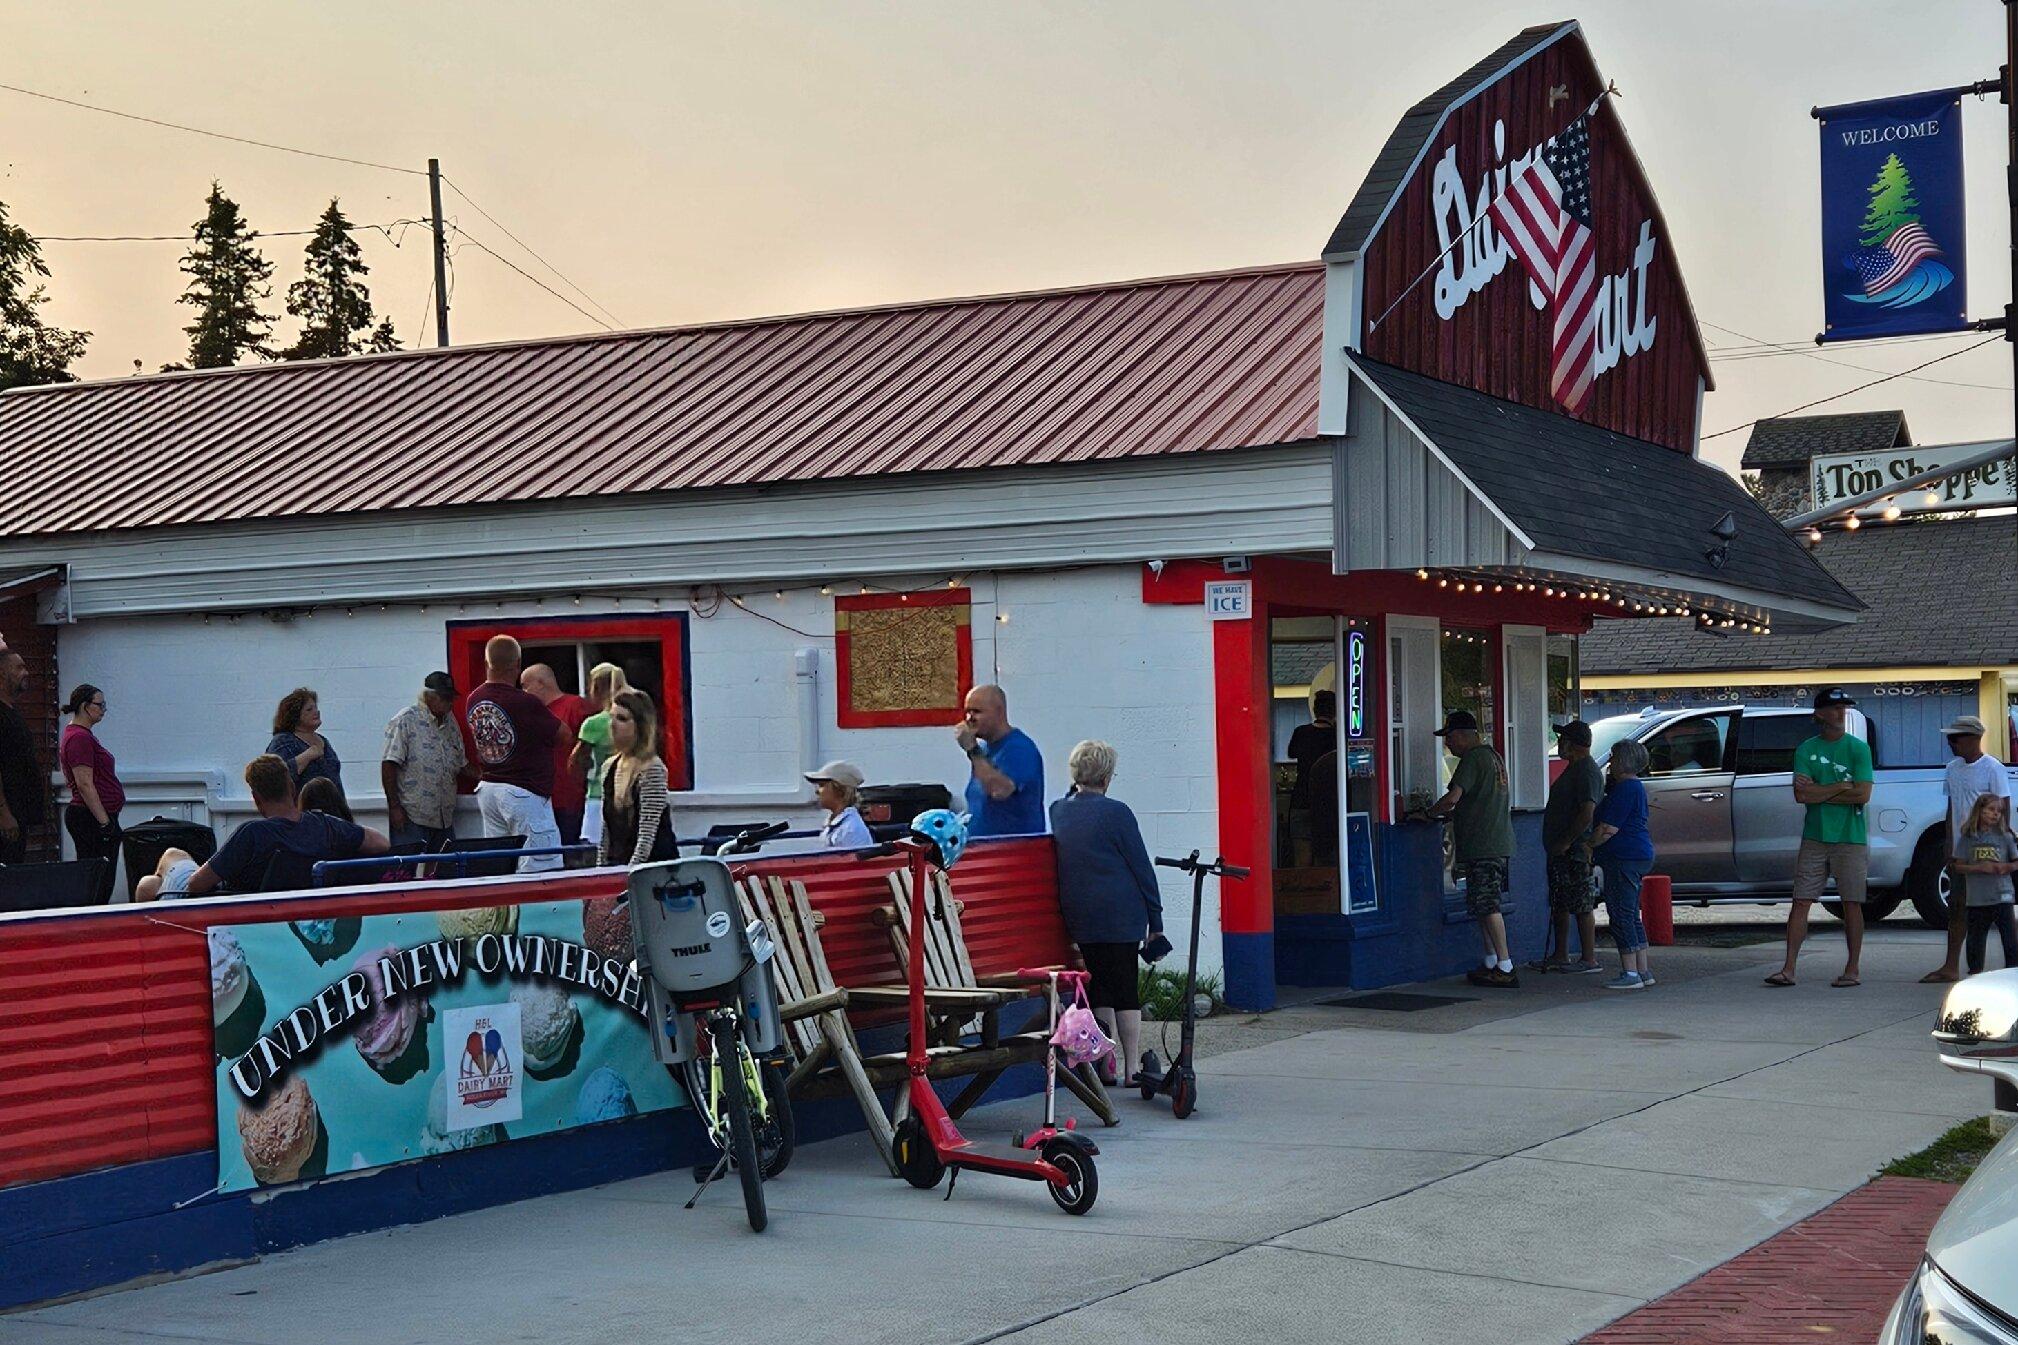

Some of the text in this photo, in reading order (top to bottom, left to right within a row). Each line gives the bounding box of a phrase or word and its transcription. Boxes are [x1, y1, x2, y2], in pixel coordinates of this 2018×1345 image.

[1842, 120, 1940, 146] WELCOME
[1433, 119, 1556, 320] Dai
[1213, 597, 1242, 612] ICE
[1351, 638, 1361, 730] OPEN
[671, 942, 712, 957] THULE
[229, 933, 649, 1097] UNDER NEW OWNERSH
[458, 1075, 513, 1093] DAIRY MART
